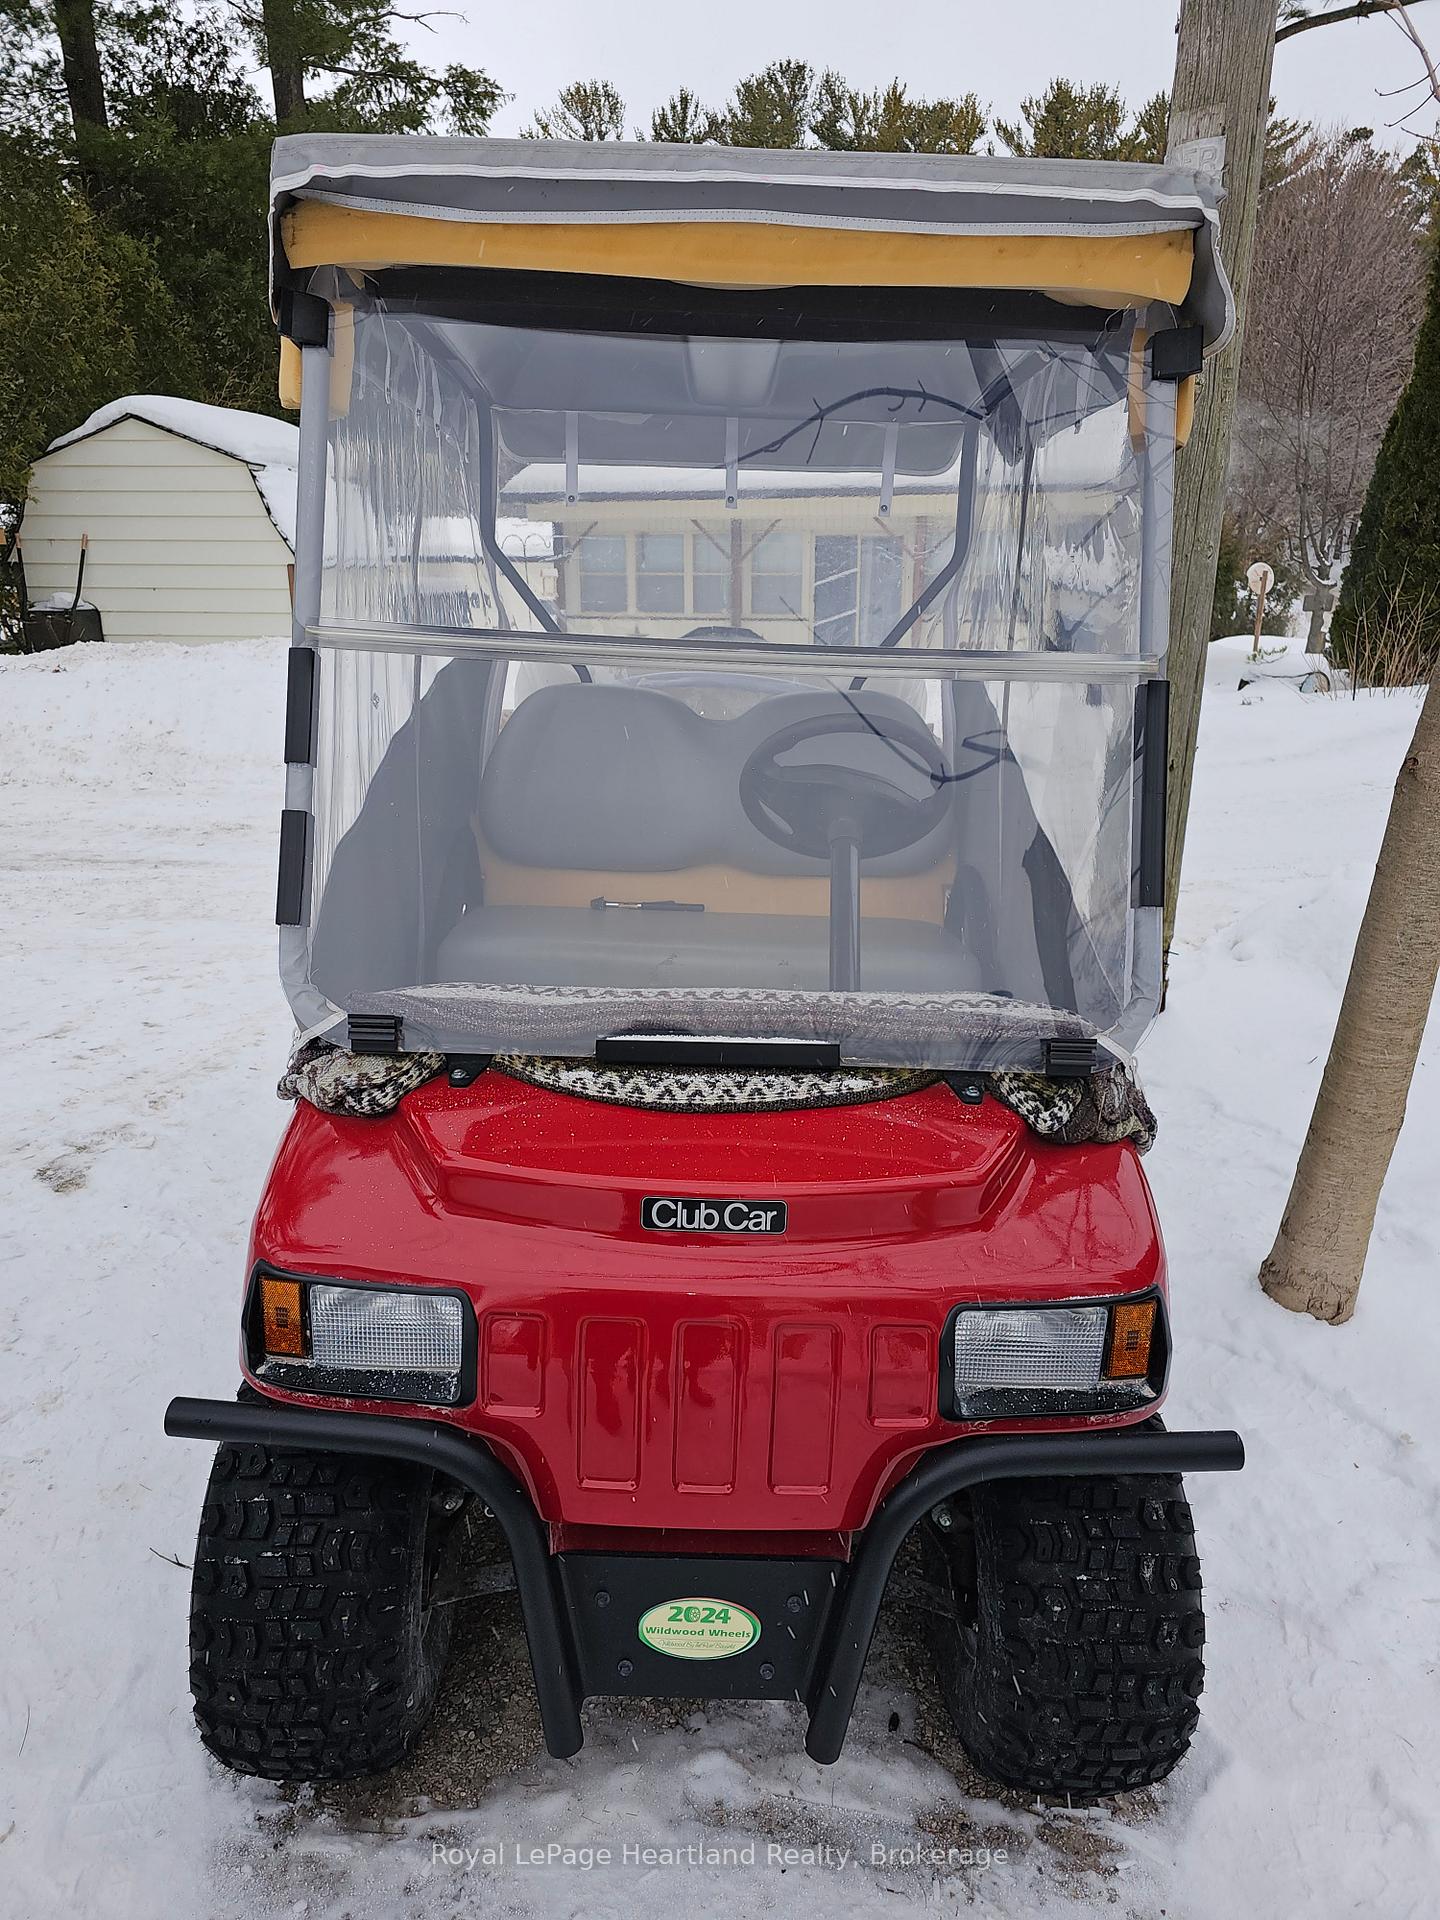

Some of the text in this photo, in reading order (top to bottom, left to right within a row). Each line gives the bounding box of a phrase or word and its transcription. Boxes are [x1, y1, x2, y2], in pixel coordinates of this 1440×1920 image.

[651, 1200, 778, 1231] Club Car
[667, 1605, 732, 1624] 2024
[645, 1626, 752, 1639] Wildwood Wheels
